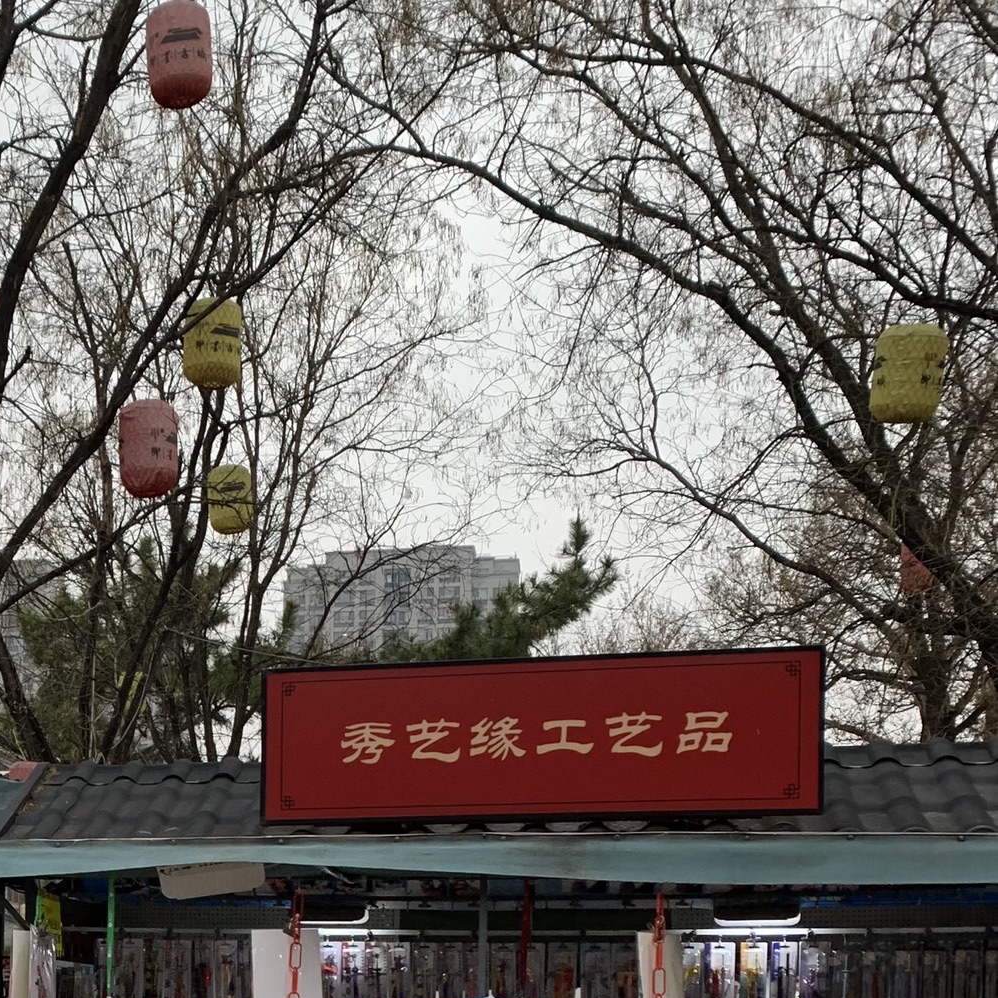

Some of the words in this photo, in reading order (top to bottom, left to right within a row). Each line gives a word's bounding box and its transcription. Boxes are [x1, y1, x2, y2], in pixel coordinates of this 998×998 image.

[340, 709, 734, 765] 秀艺缘工艺品
